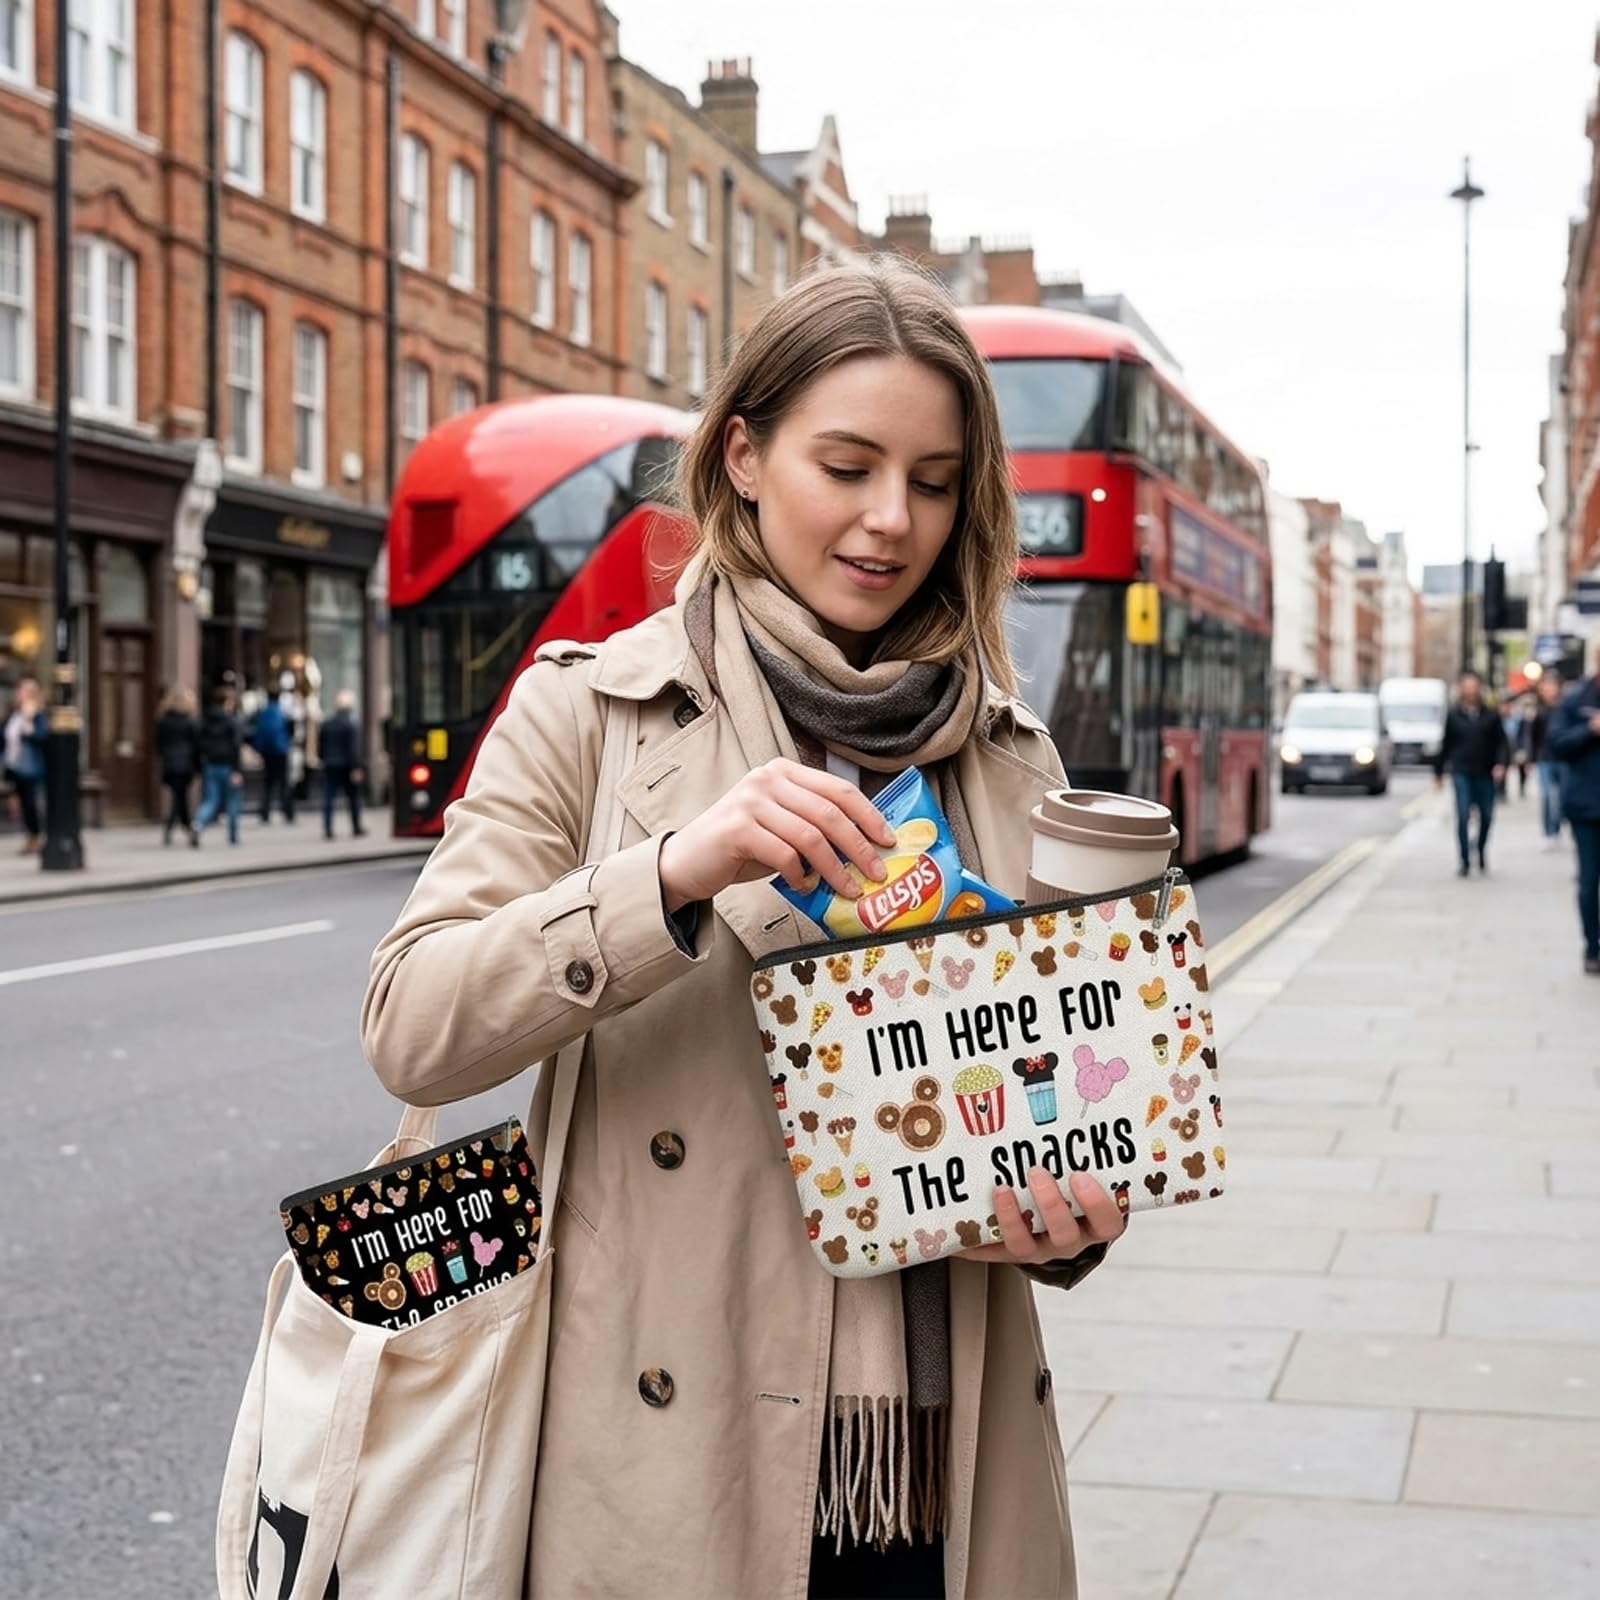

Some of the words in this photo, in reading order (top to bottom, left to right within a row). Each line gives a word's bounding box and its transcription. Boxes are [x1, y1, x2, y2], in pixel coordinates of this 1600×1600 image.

[866, 1019, 928, 1077] I'm
[945, 994, 1042, 1060] Here
[892, 1156, 969, 1215] The
[990, 1117, 1137, 1189] snacks
[351, 1230, 390, 1268] I'm
[394, 1206, 452, 1252] Here
